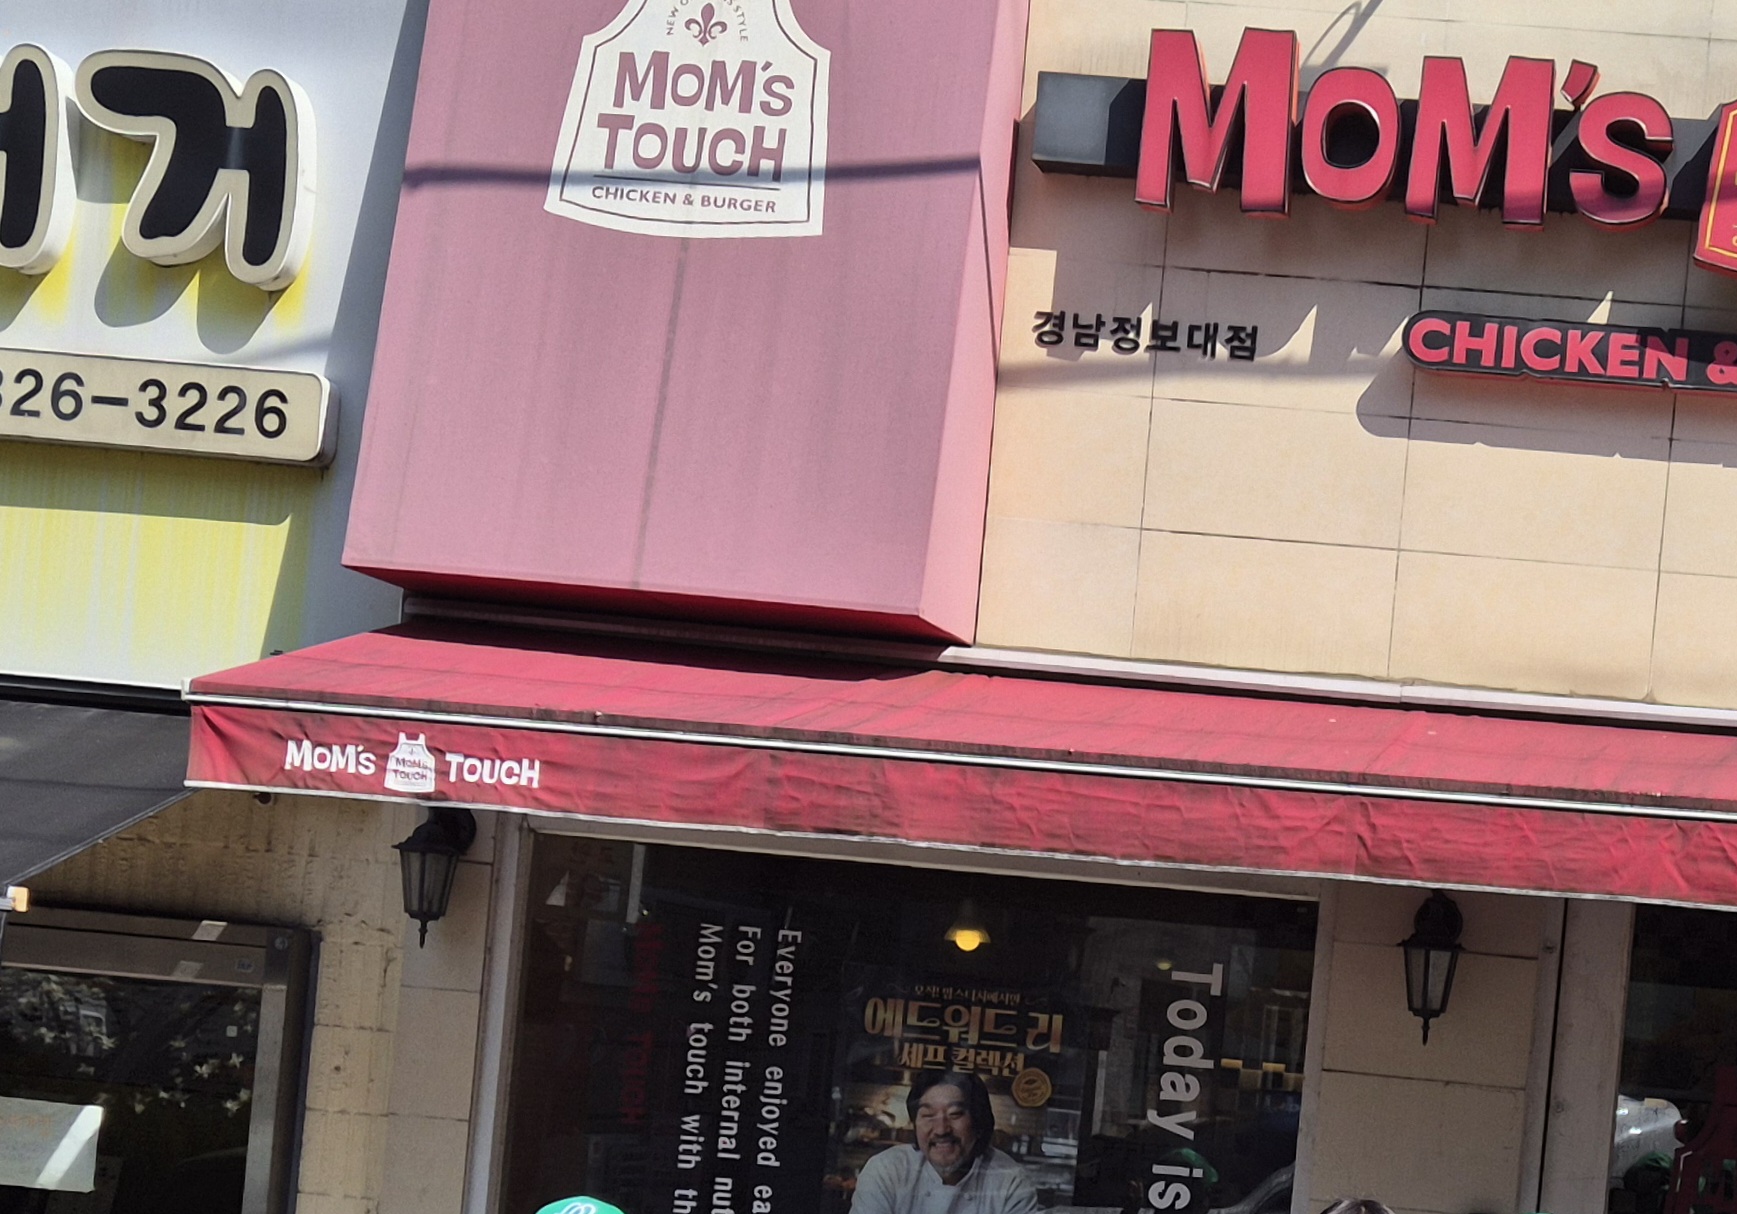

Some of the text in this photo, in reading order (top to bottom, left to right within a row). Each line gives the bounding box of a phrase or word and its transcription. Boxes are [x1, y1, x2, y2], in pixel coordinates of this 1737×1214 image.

[0, 43, 314, 292] 거
[596, 112, 788, 183] TOUCH
[591, 185, 778, 213] CHICKEN & BURGER
[1032, 309, 1259, 362] 경남정보대점
[1407, 316, 1688, 384] CHICKEN
[0, 366, 289, 441] 26-3226
[445, 752, 541, 788] TOUCH
[692, 922, 724, 1003] Mom's
[735, 925, 762, 966] For
[727, 983, 757, 1042] both
[768, 928, 803, 1047] Everyone
[684, 1021, 714, 1095] touch
[864, 997, 1064, 1054] 에드워드 리
[1147, 962, 1224, 1141] Today
[952, 1048, 1026, 1078] 컬렉션
[676, 1113, 706, 1170] with
[716, 1060, 752, 1160] internal
[756, 1065, 788, 1168] enjoyed
[1148, 1163, 1204, 1211] is
